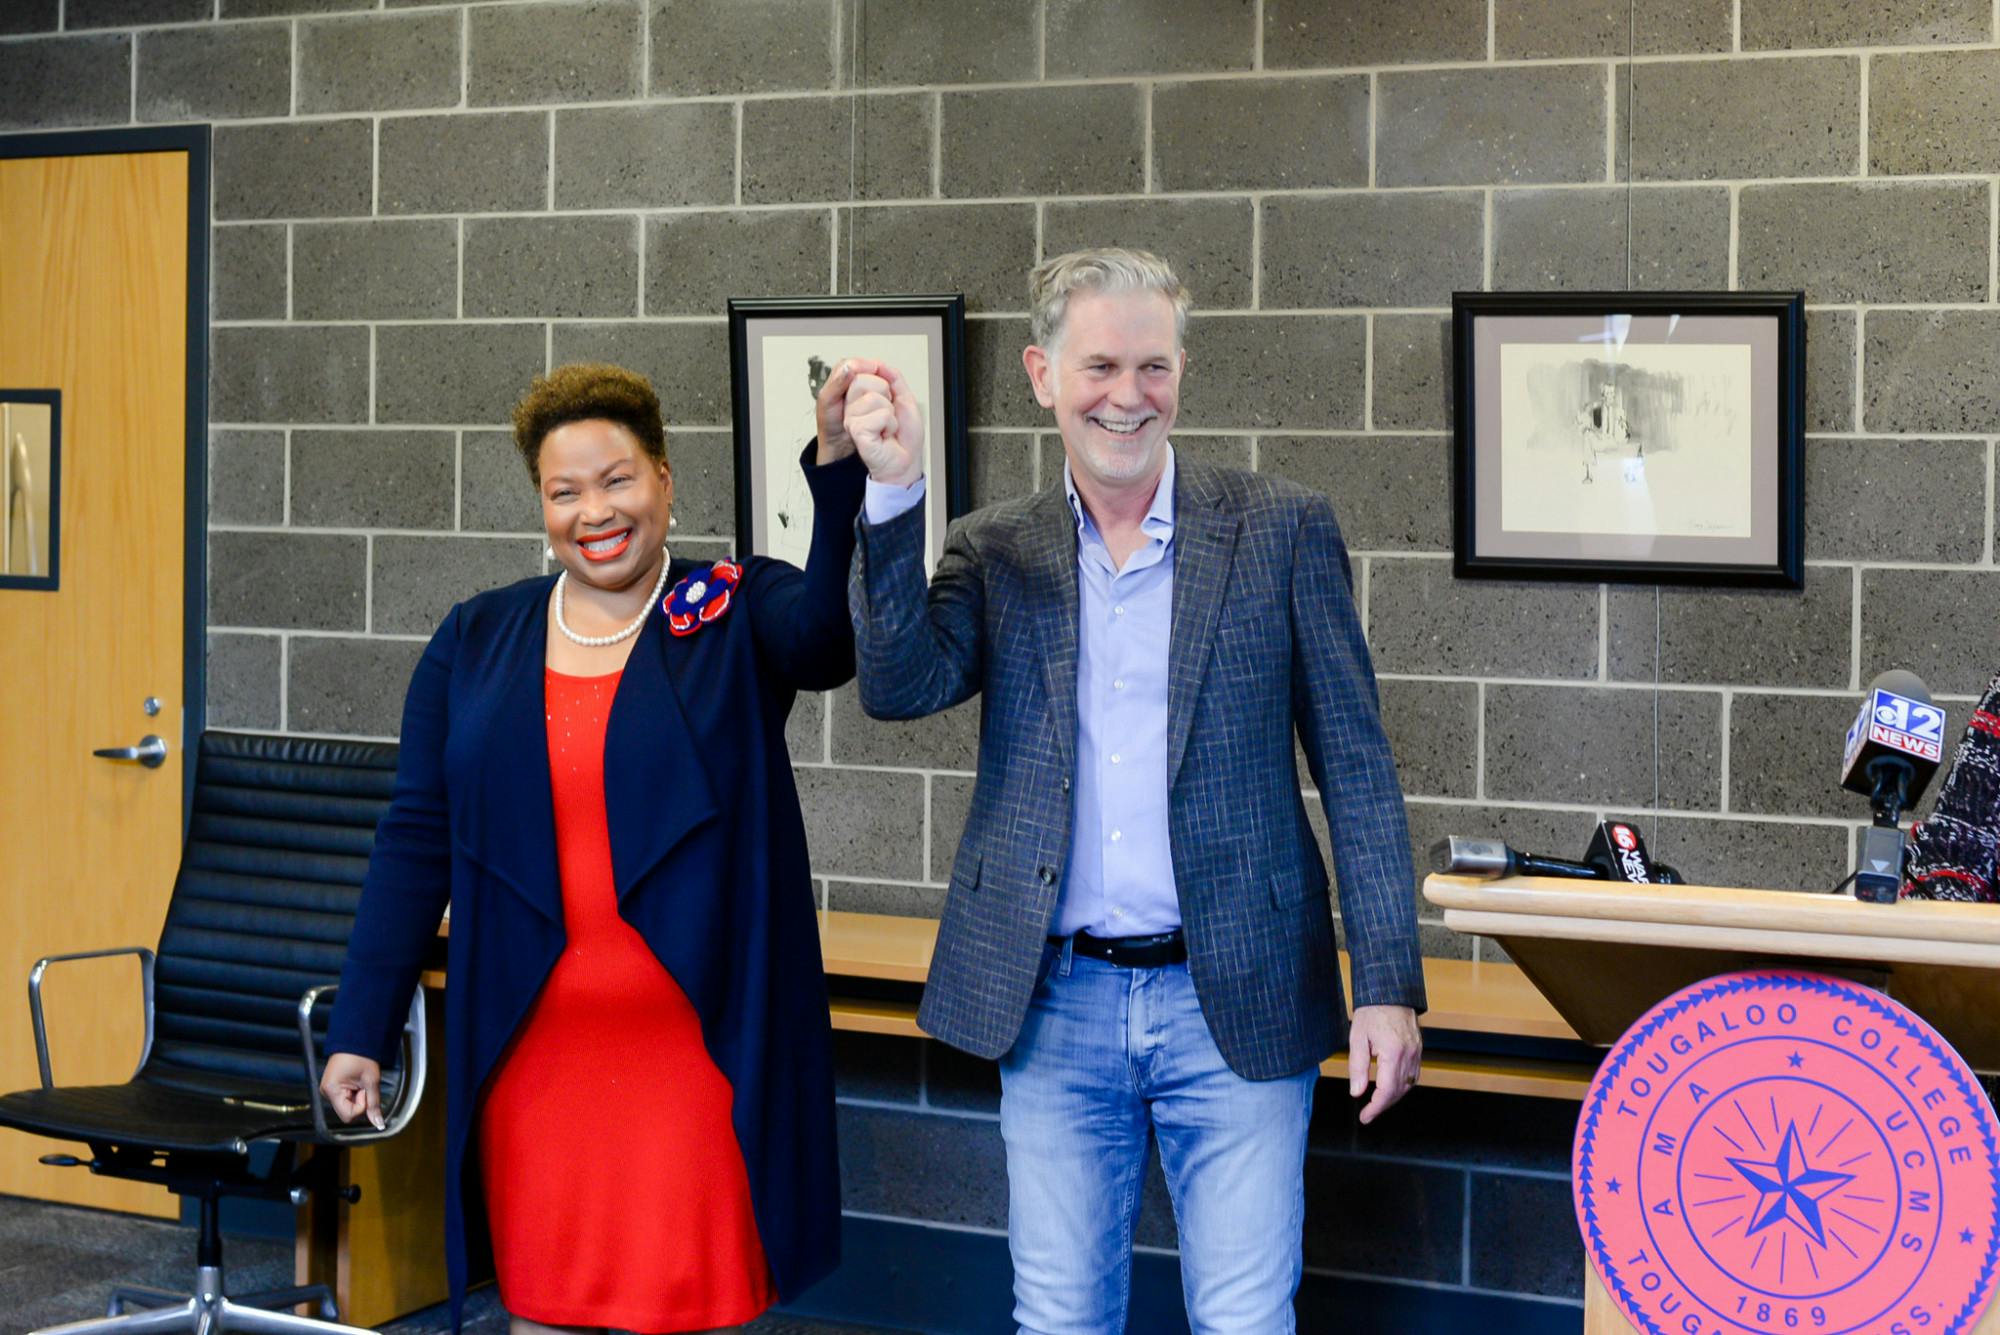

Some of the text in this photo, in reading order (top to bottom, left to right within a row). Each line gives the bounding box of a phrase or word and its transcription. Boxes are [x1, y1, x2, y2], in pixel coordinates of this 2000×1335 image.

[1891, 698, 1941, 741] 12
[1873, 726, 1938, 759] NEWS
[1617, 1002, 1972, 1165] TOUGALOO COLLEGE
[1736, 1295, 1827, 1327] 1869
